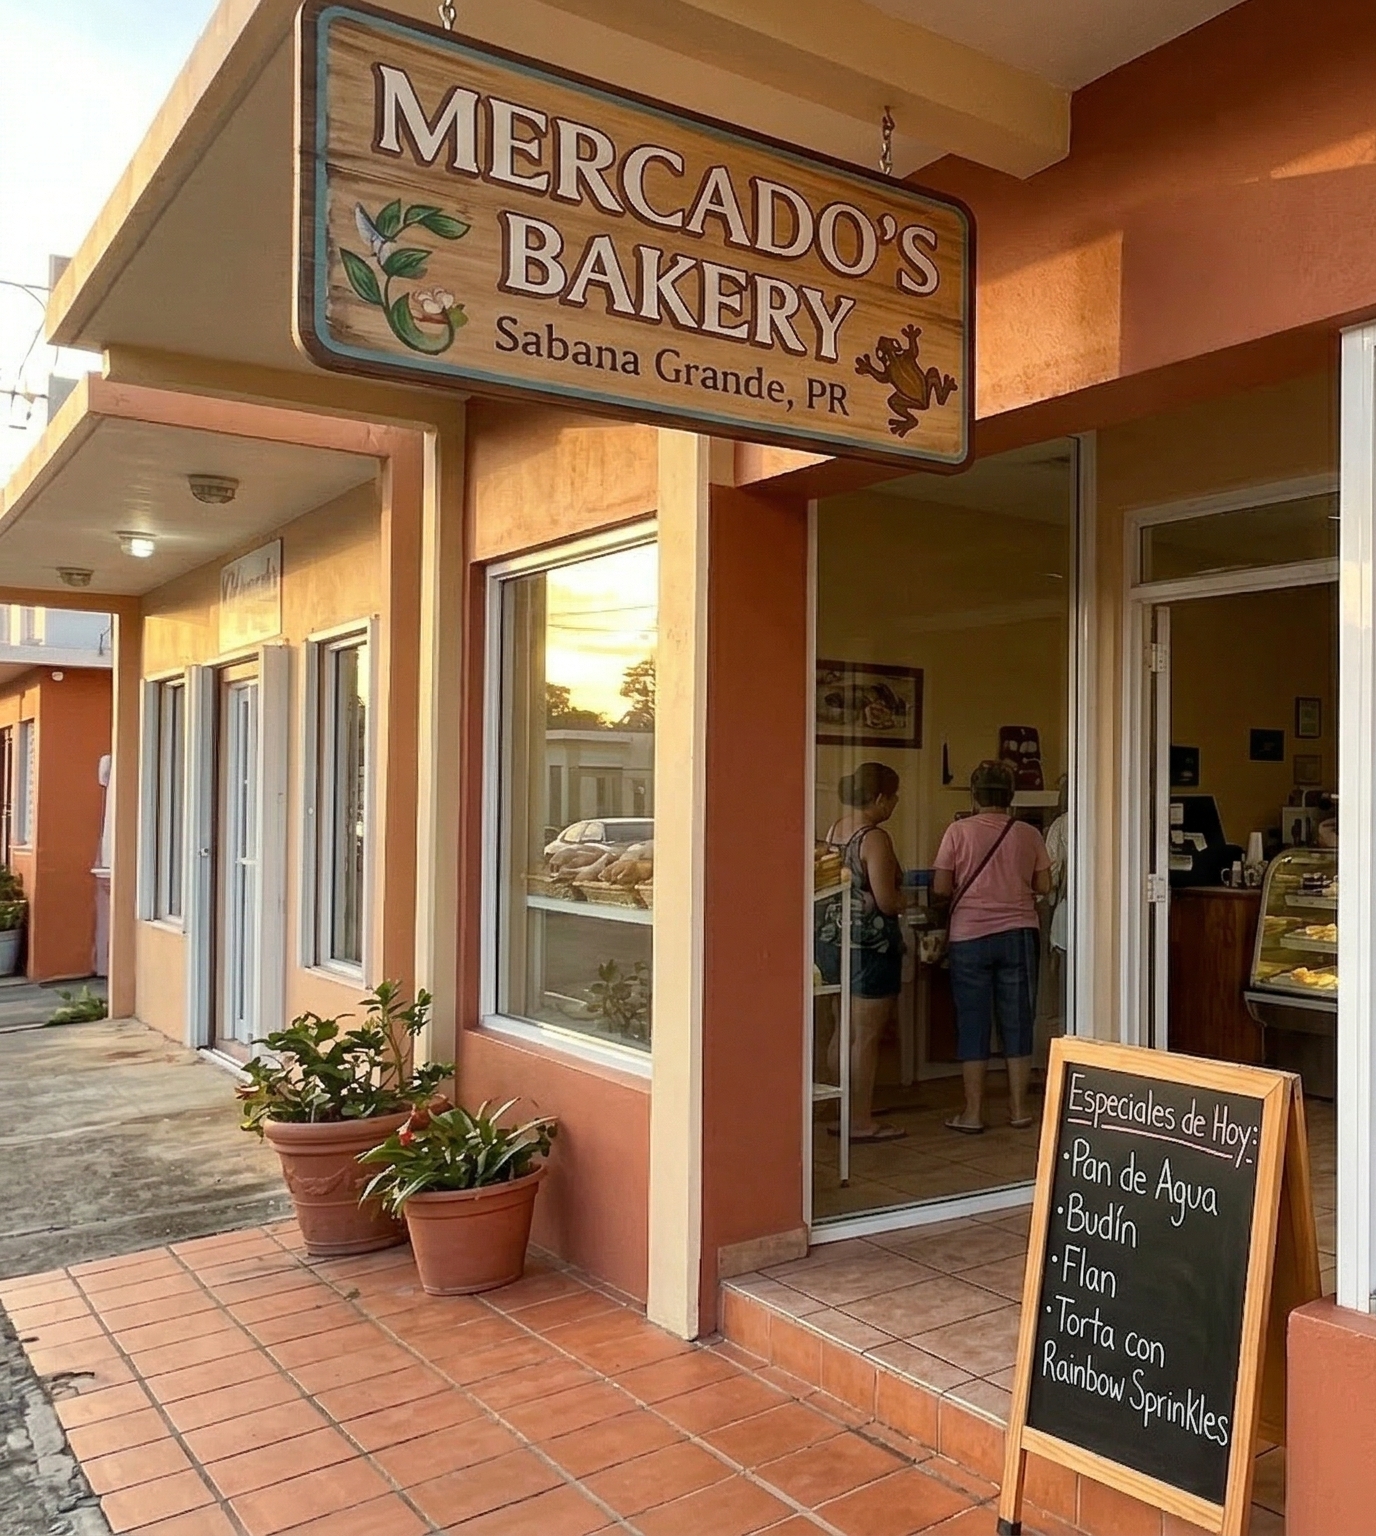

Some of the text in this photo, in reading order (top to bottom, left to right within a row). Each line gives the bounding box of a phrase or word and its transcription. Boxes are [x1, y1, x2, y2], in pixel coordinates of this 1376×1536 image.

[375, 63, 940, 296] MERCADO'S
[497, 210, 857, 363] BAKERY
[495, 315, 850, 417] Sabana Grande, PR
[1068, 1073, 1259, 1168] Especiales de Hoy:
[1067, 1193, 1136, 1249] Budín
[1071, 1138, 1219, 1227] Pan de Agua
[1061, 1244, 1117, 1299] Flan
[1056, 1295, 1165, 1368] Torta con
[1042, 1340, 1229, 1446] Rainbow Sprinkles
